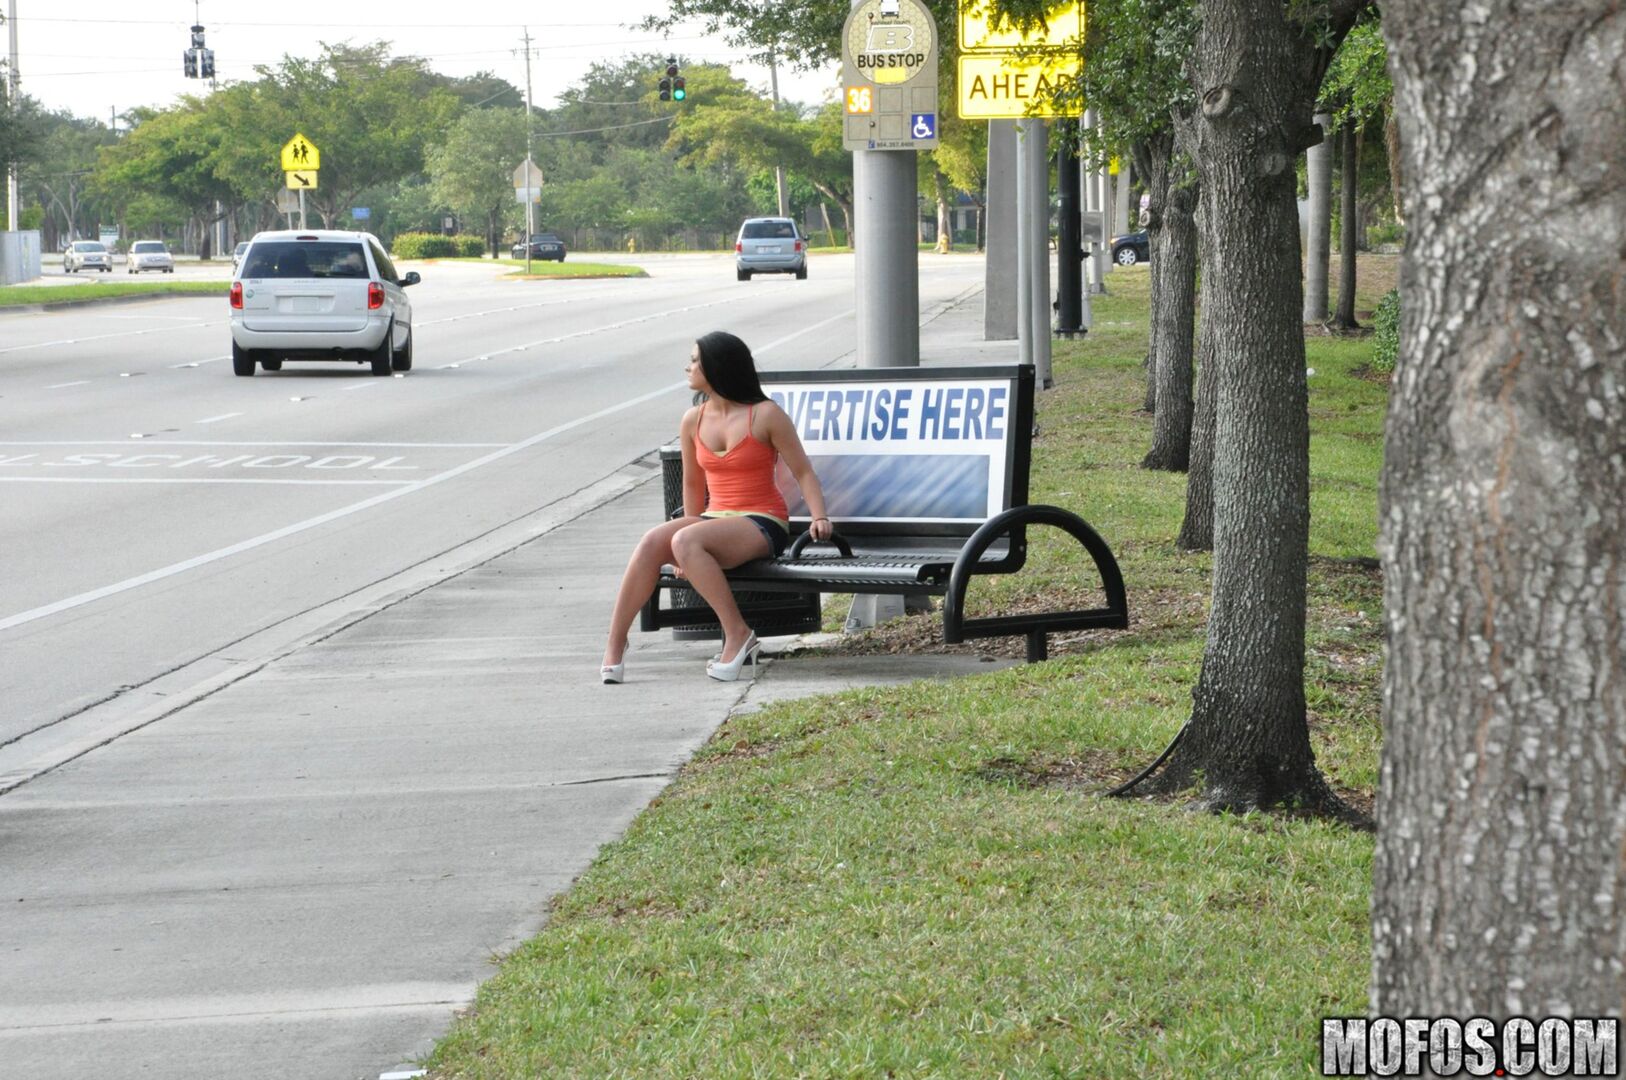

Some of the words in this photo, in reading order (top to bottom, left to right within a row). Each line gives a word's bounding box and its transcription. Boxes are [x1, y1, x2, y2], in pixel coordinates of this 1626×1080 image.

[857, 54, 885, 68] BUS
[888, 53, 924, 67] STOP
[848, 87, 872, 113] 36
[771, 389, 912, 441] VERTISE
[918, 387, 1006, 440] HERE
[42, 453, 420, 470] SCHOOL
